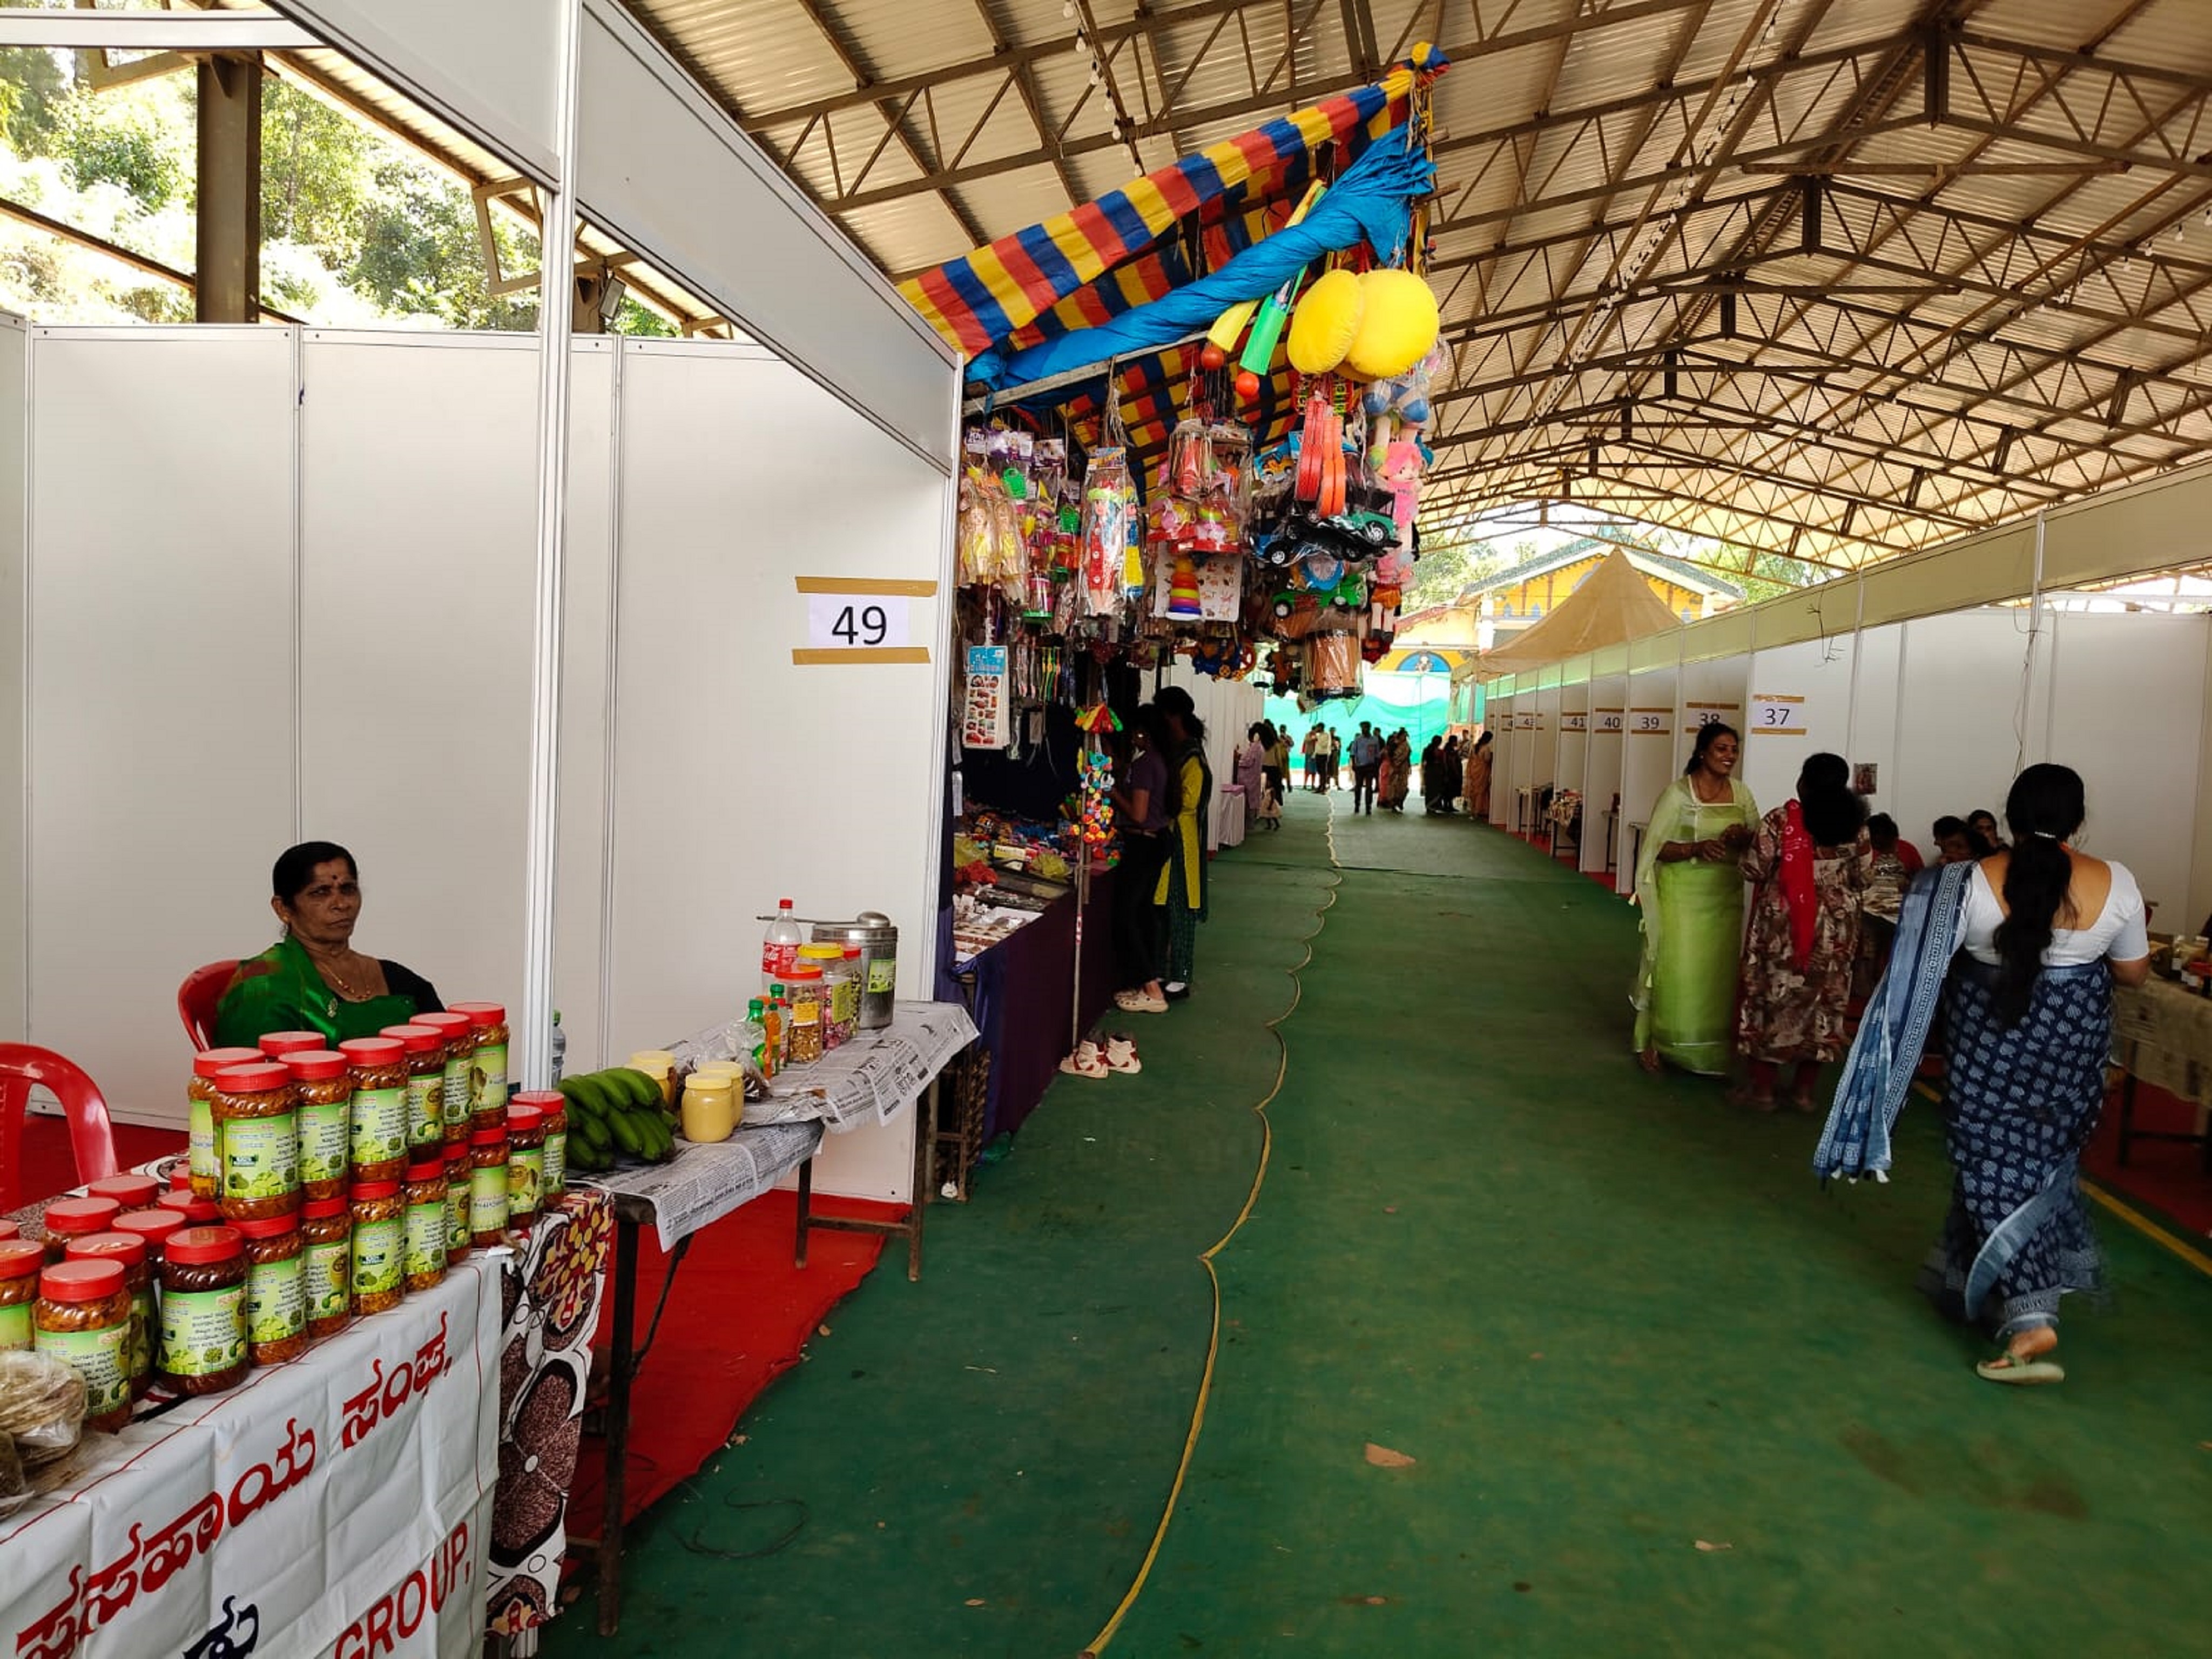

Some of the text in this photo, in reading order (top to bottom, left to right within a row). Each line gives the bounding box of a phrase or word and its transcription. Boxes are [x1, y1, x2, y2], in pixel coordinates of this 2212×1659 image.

[832, 605, 887, 645] 49
[1570, 717, 1584, 727] 41
[1700, 713, 1721, 726] 38
[1764, 708, 1790, 725] 37
[1604, 717, 1620, 729] 40
[1641, 717, 1660, 729] 39
